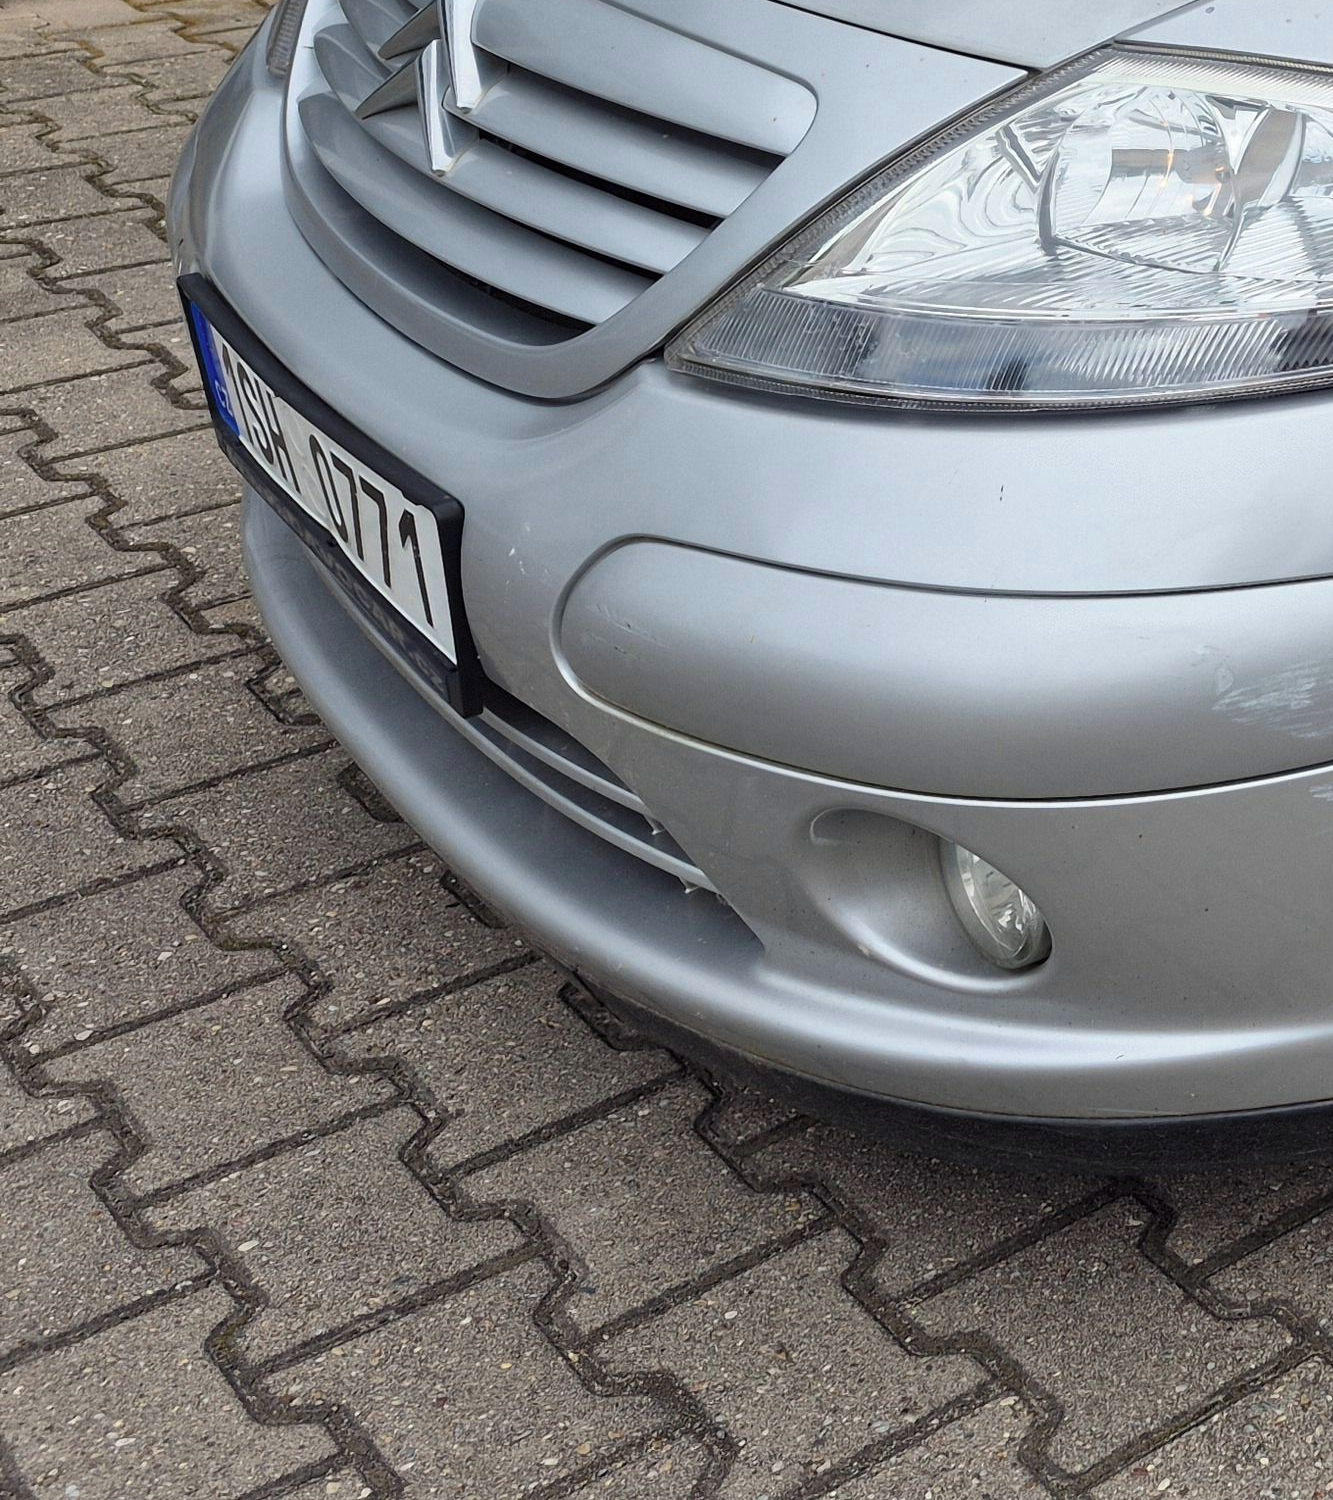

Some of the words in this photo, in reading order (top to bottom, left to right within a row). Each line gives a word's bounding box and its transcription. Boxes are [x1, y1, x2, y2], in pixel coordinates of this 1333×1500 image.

[214, 379, 234, 416] CZ
[222, 343, 302, 495] 1SH
[308, 434, 435, 629] 0771
